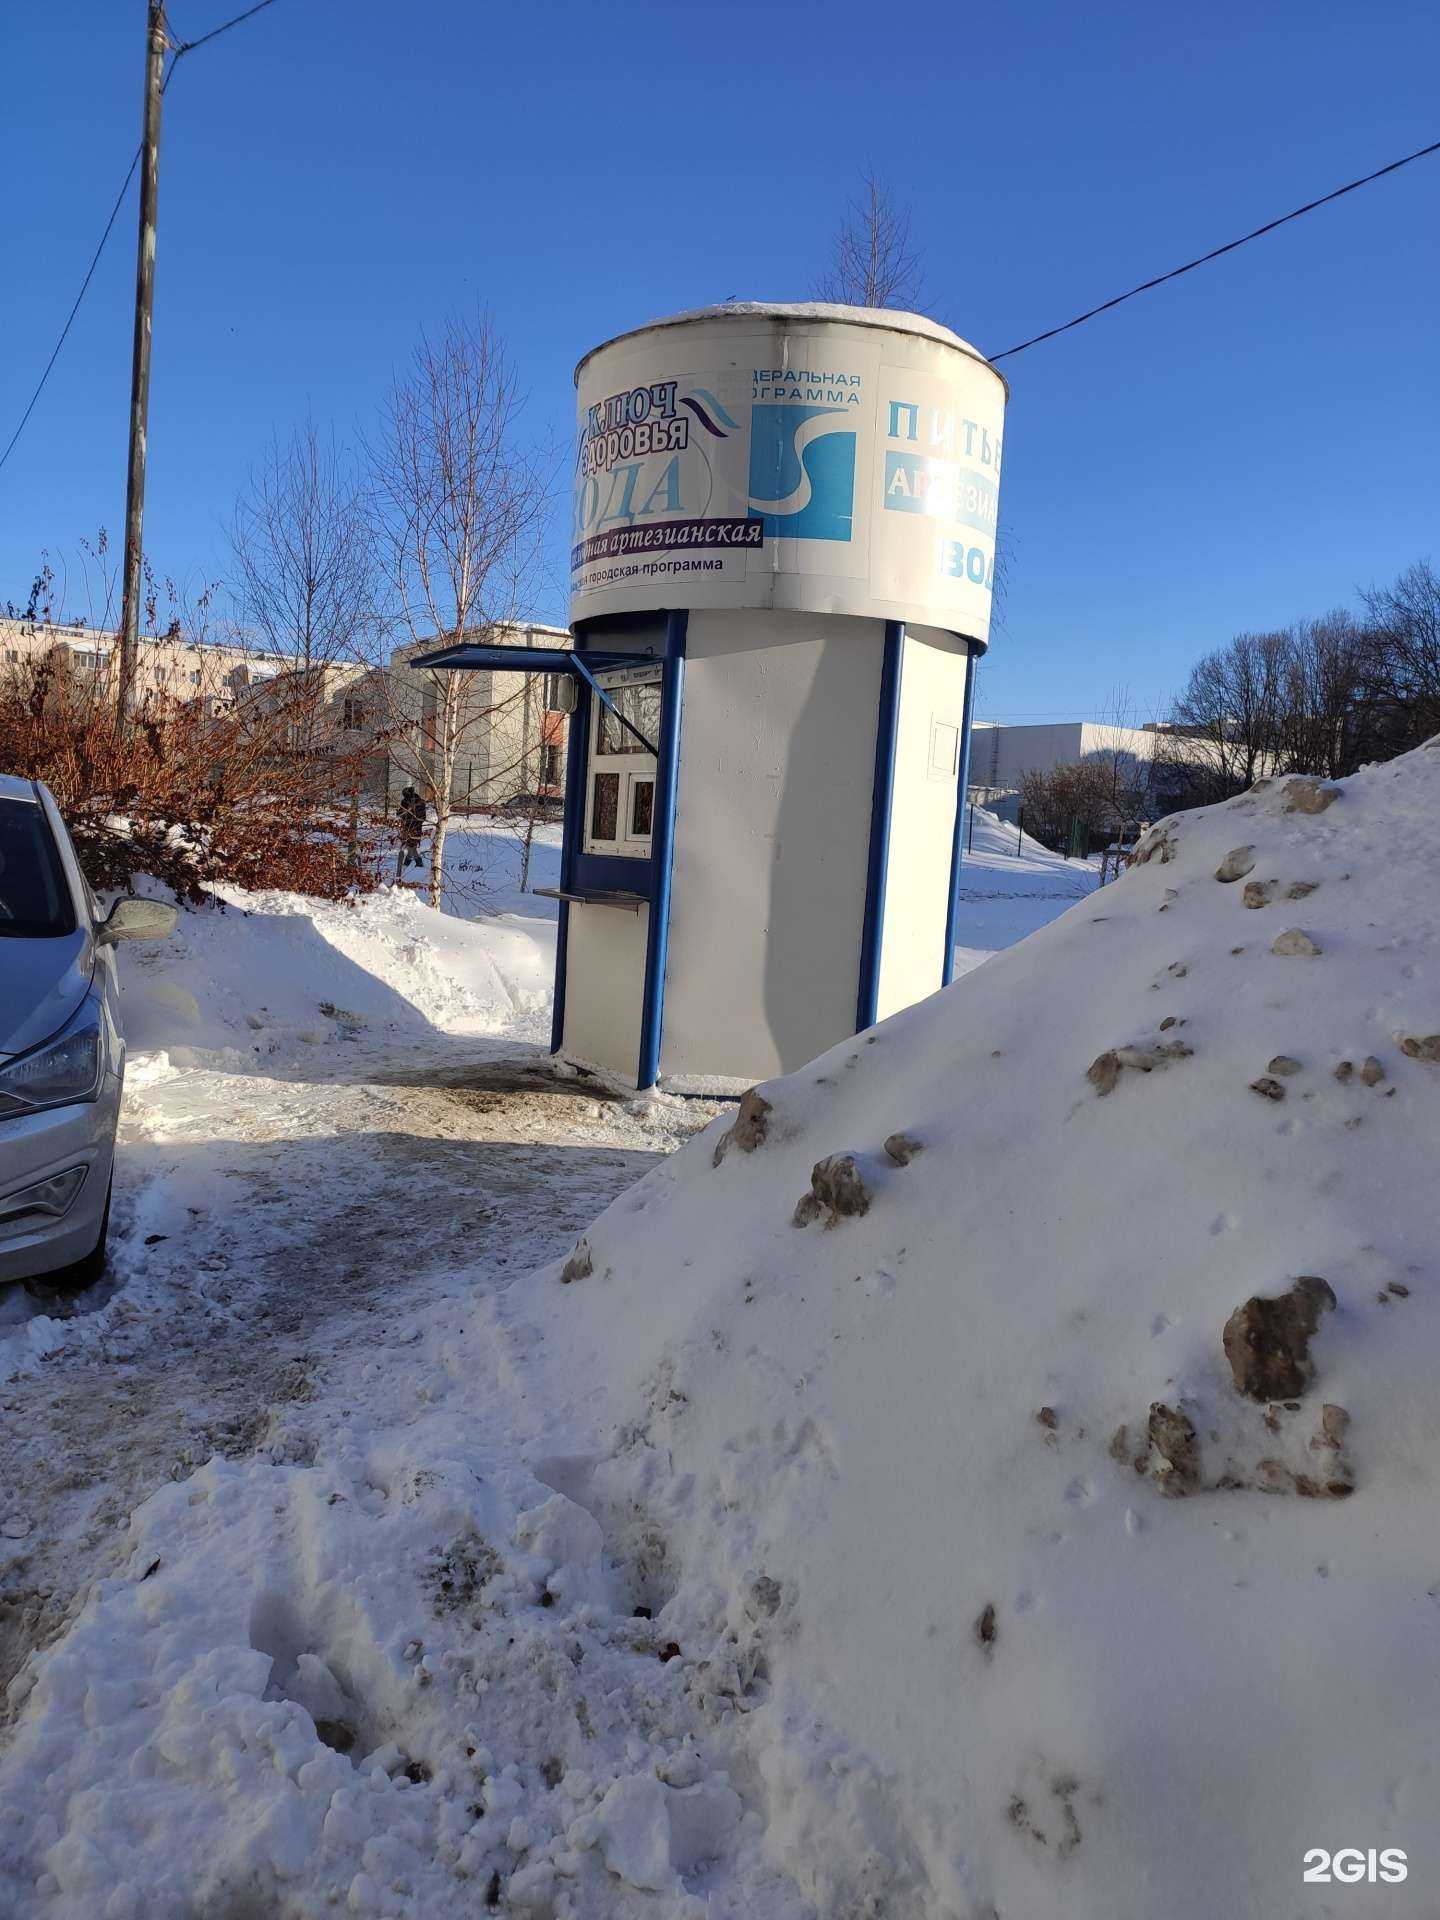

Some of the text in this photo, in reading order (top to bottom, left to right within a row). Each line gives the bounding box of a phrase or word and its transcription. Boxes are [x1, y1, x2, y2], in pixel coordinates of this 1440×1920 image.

[575, 454, 684, 535] ОДА
[611, 522, 762, 556] артезианская
[589, 564, 639, 584] городская
[642, 558, 723, 577] программа
